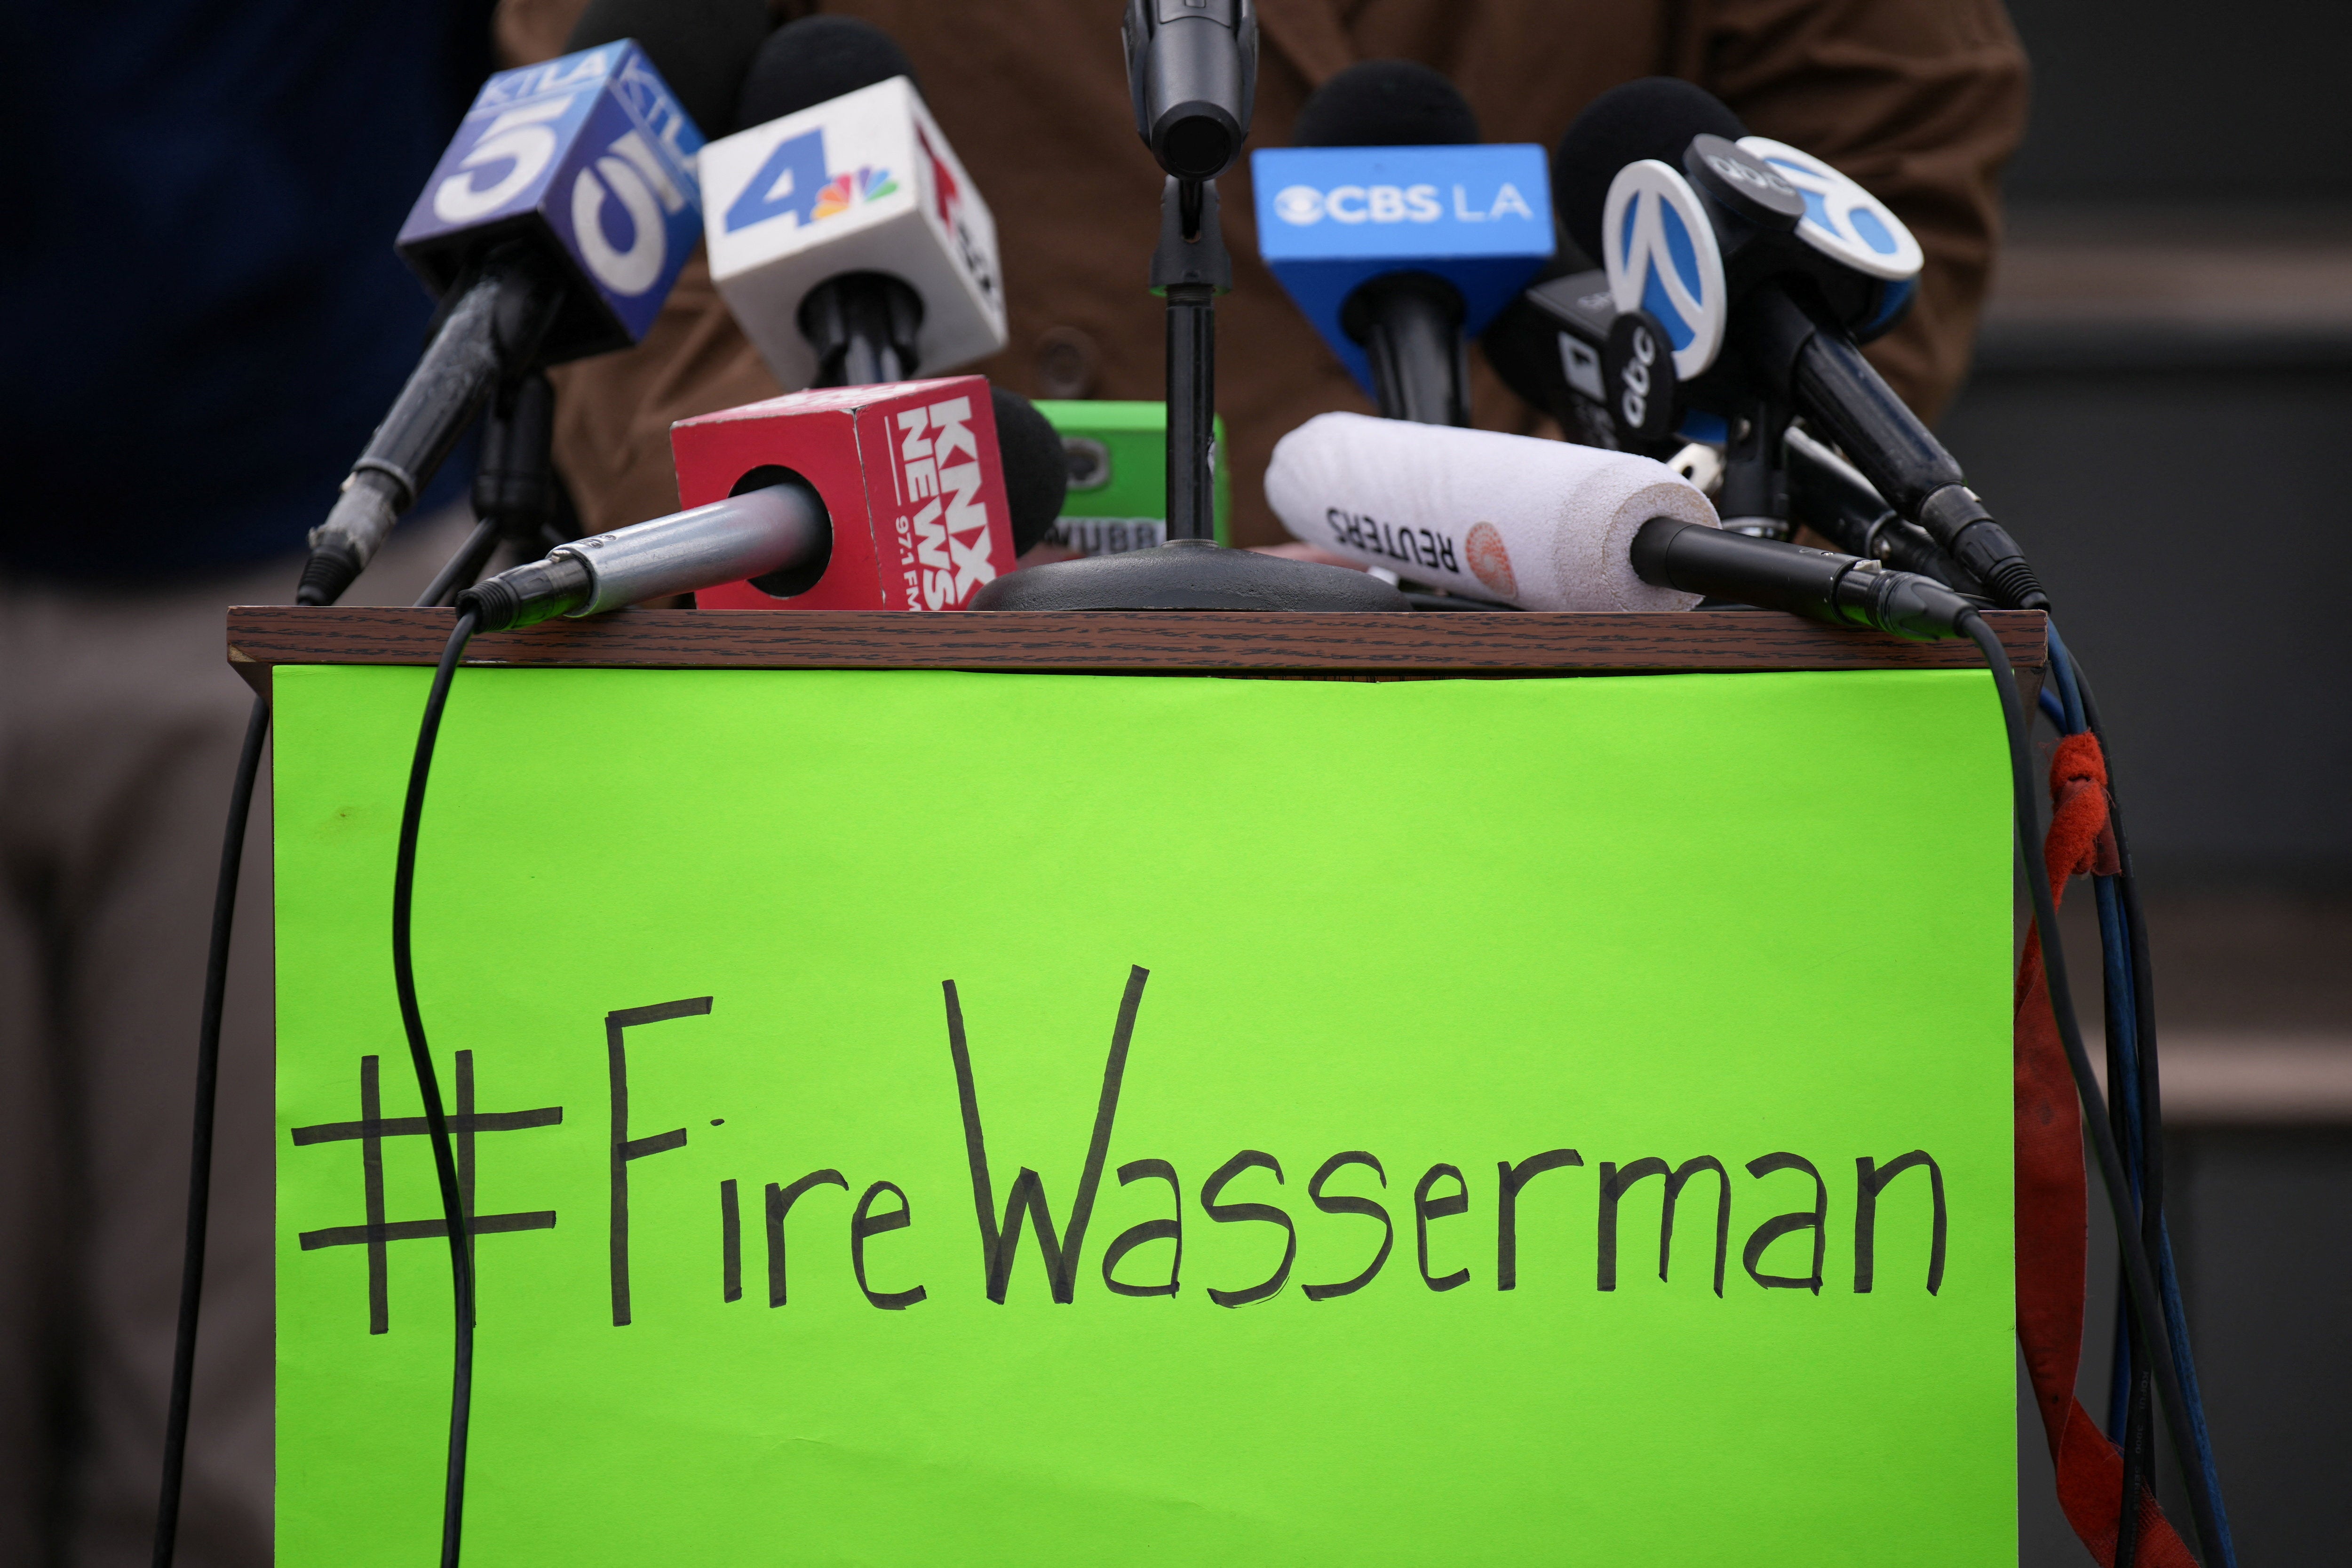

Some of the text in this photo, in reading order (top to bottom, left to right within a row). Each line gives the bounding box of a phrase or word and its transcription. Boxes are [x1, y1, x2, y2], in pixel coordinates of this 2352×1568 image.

[474, 49, 610, 112] KTLA
[433, 95, 575, 223] 5
[724, 126, 831, 236] 4
[1326, 182, 1534, 224] CBS LA
[1705, 153, 1797, 197] abc
[571, 128, 686, 297] 5
[1622, 326, 1656, 429] abc
[897, 406, 956, 611] NEWS
[928, 395, 996, 604] KNX
[1326, 506, 1459, 574] REUTERS
[896, 515, 922, 611] 97.1 FM
[290, 964, 1947, 1335] #FireWasserman
[2135, 1424, 2144, 1454] 3000
